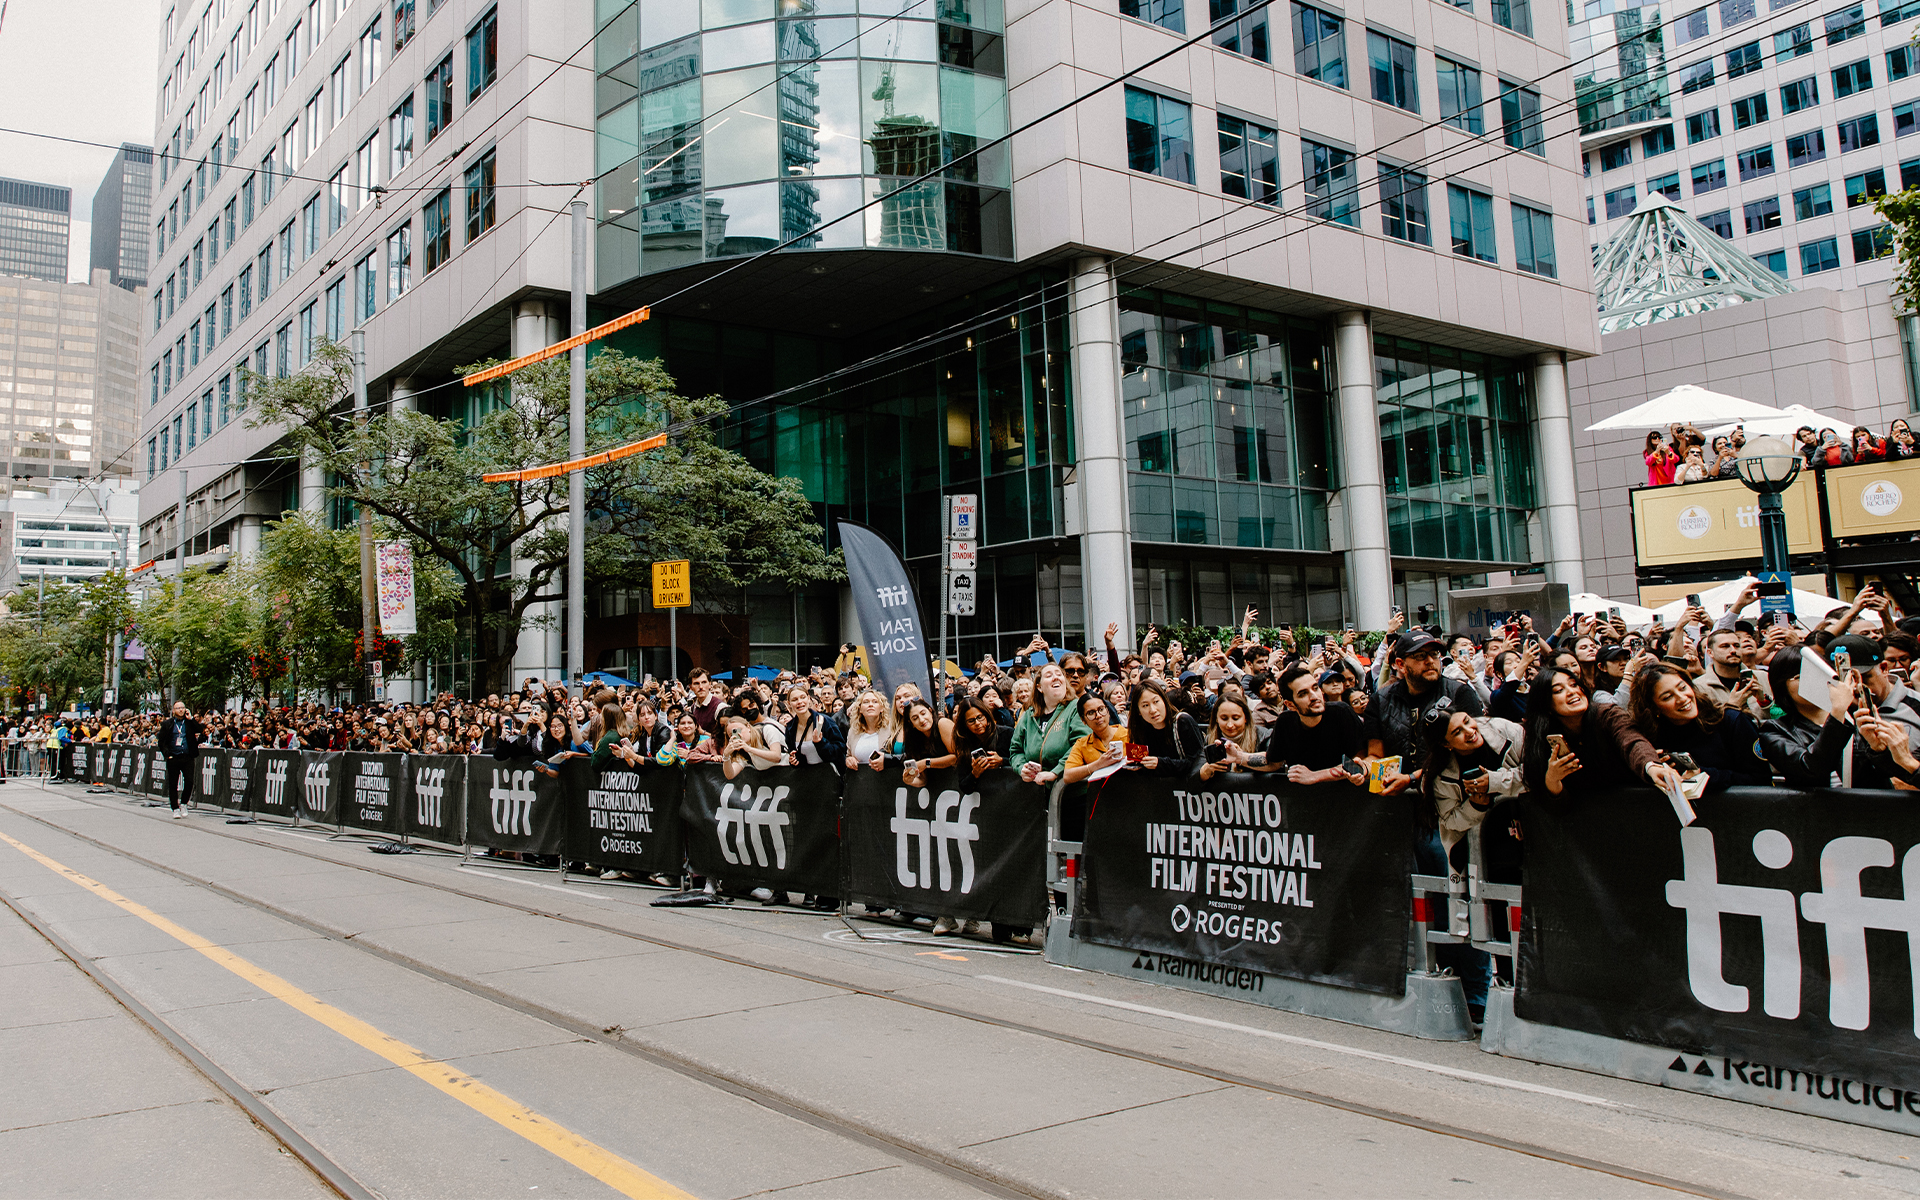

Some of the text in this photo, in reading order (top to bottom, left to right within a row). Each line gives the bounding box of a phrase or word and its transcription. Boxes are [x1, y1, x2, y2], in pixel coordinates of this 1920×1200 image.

[953, 505, 975, 513] STANDING
[960, 496, 968, 504] NO
[1735, 505, 1760, 528] tif
[952, 552, 975, 560] STANDING
[660, 563, 681, 575] DO NOT
[662, 578, 680, 589] BLOCK
[658, 592, 684, 604] DRIVEWAY
[952, 592, 973, 601] 4 TAXIS
[265, 759, 288, 805] tiff
[304, 762, 330, 812] tiff
[600, 771, 640, 791] TORONTO
[415, 766, 446, 828] tiff
[489, 768, 537, 836] tiff
[588, 789, 654, 812] INTERNATIONAL
[1172, 790, 1282, 828] TORONTO
[590, 809, 653, 833] FILM FESTIVAL
[714, 783, 791, 870] tiff
[609, 838, 643, 854] ROGERS
[890, 786, 982, 895] tiff
[1146, 822, 1322, 870] INTERNATIONAL
[1151, 857, 1314, 908] FILM FESTIVAL
[1207, 900, 1246, 911] PRESENTED BY
[1194, 909, 1283, 945] ROGERS
